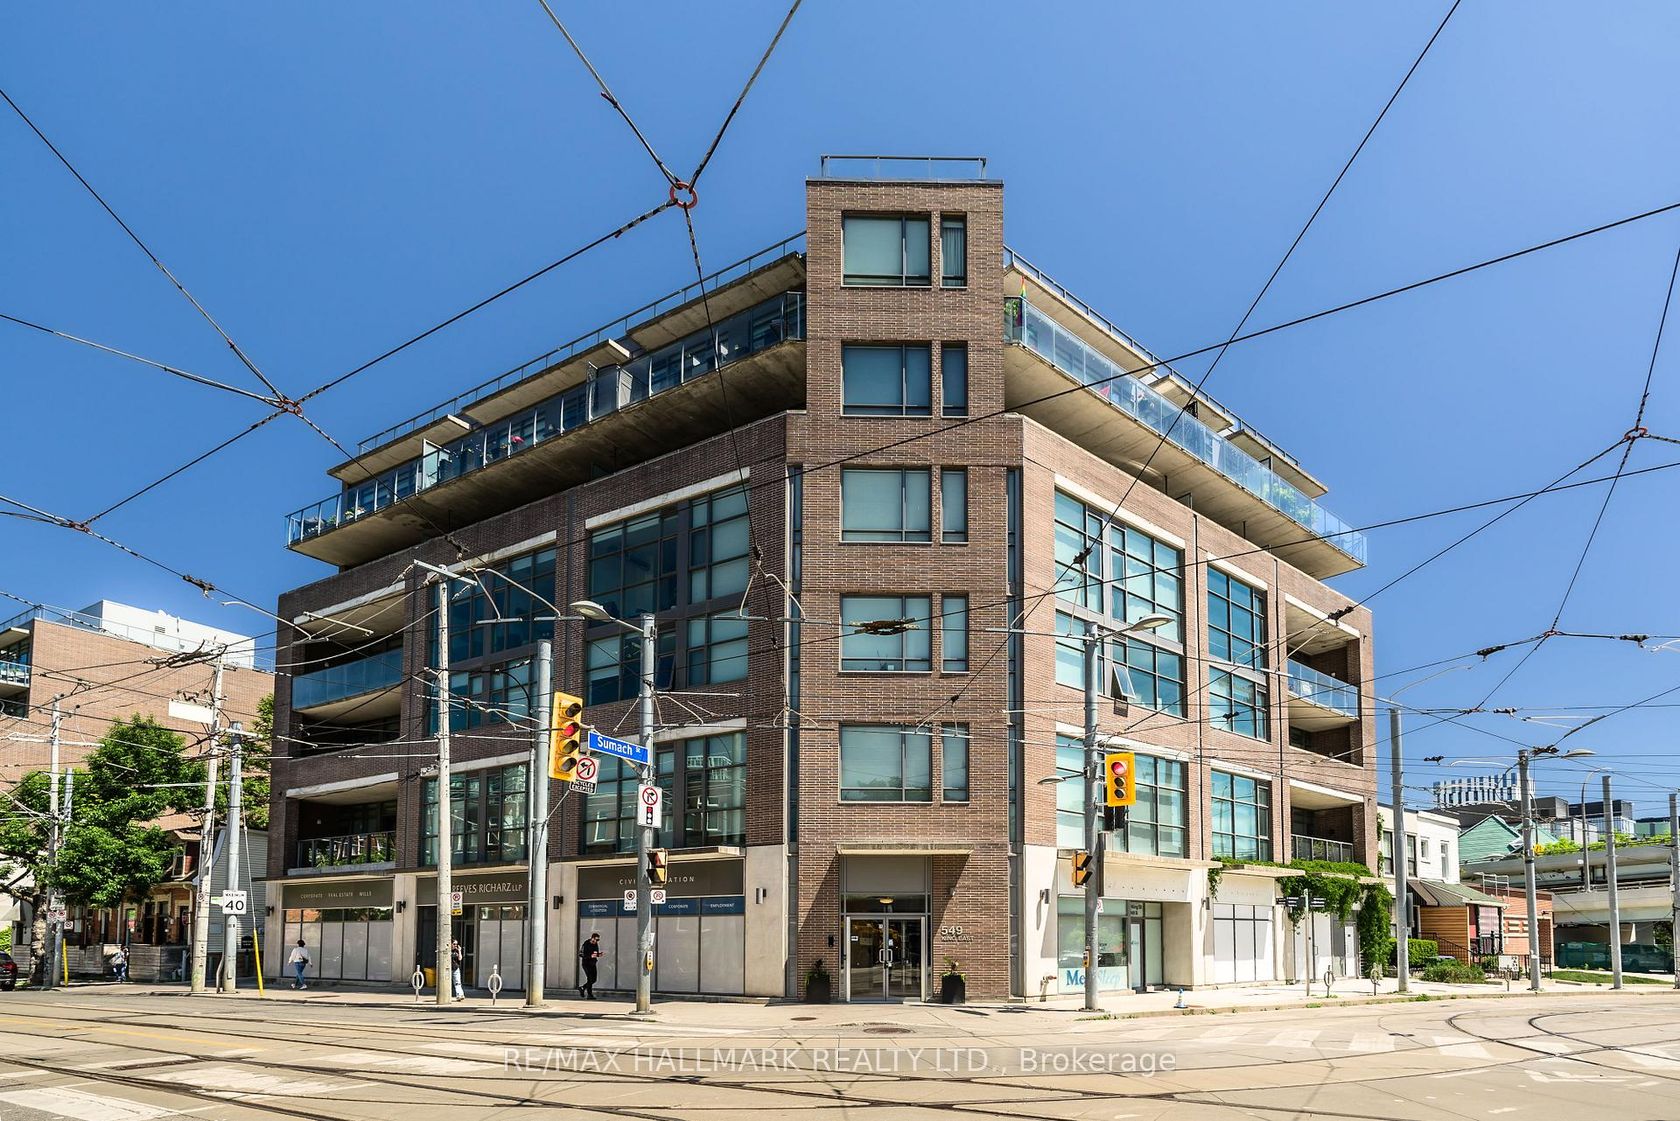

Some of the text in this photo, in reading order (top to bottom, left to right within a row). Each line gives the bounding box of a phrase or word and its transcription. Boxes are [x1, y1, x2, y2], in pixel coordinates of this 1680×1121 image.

[597, 735, 633, 756] Sumach
[479, 882, 511, 893] RICHARZ
[225, 900, 244, 911] 40
[941, 925, 963, 935] 549
